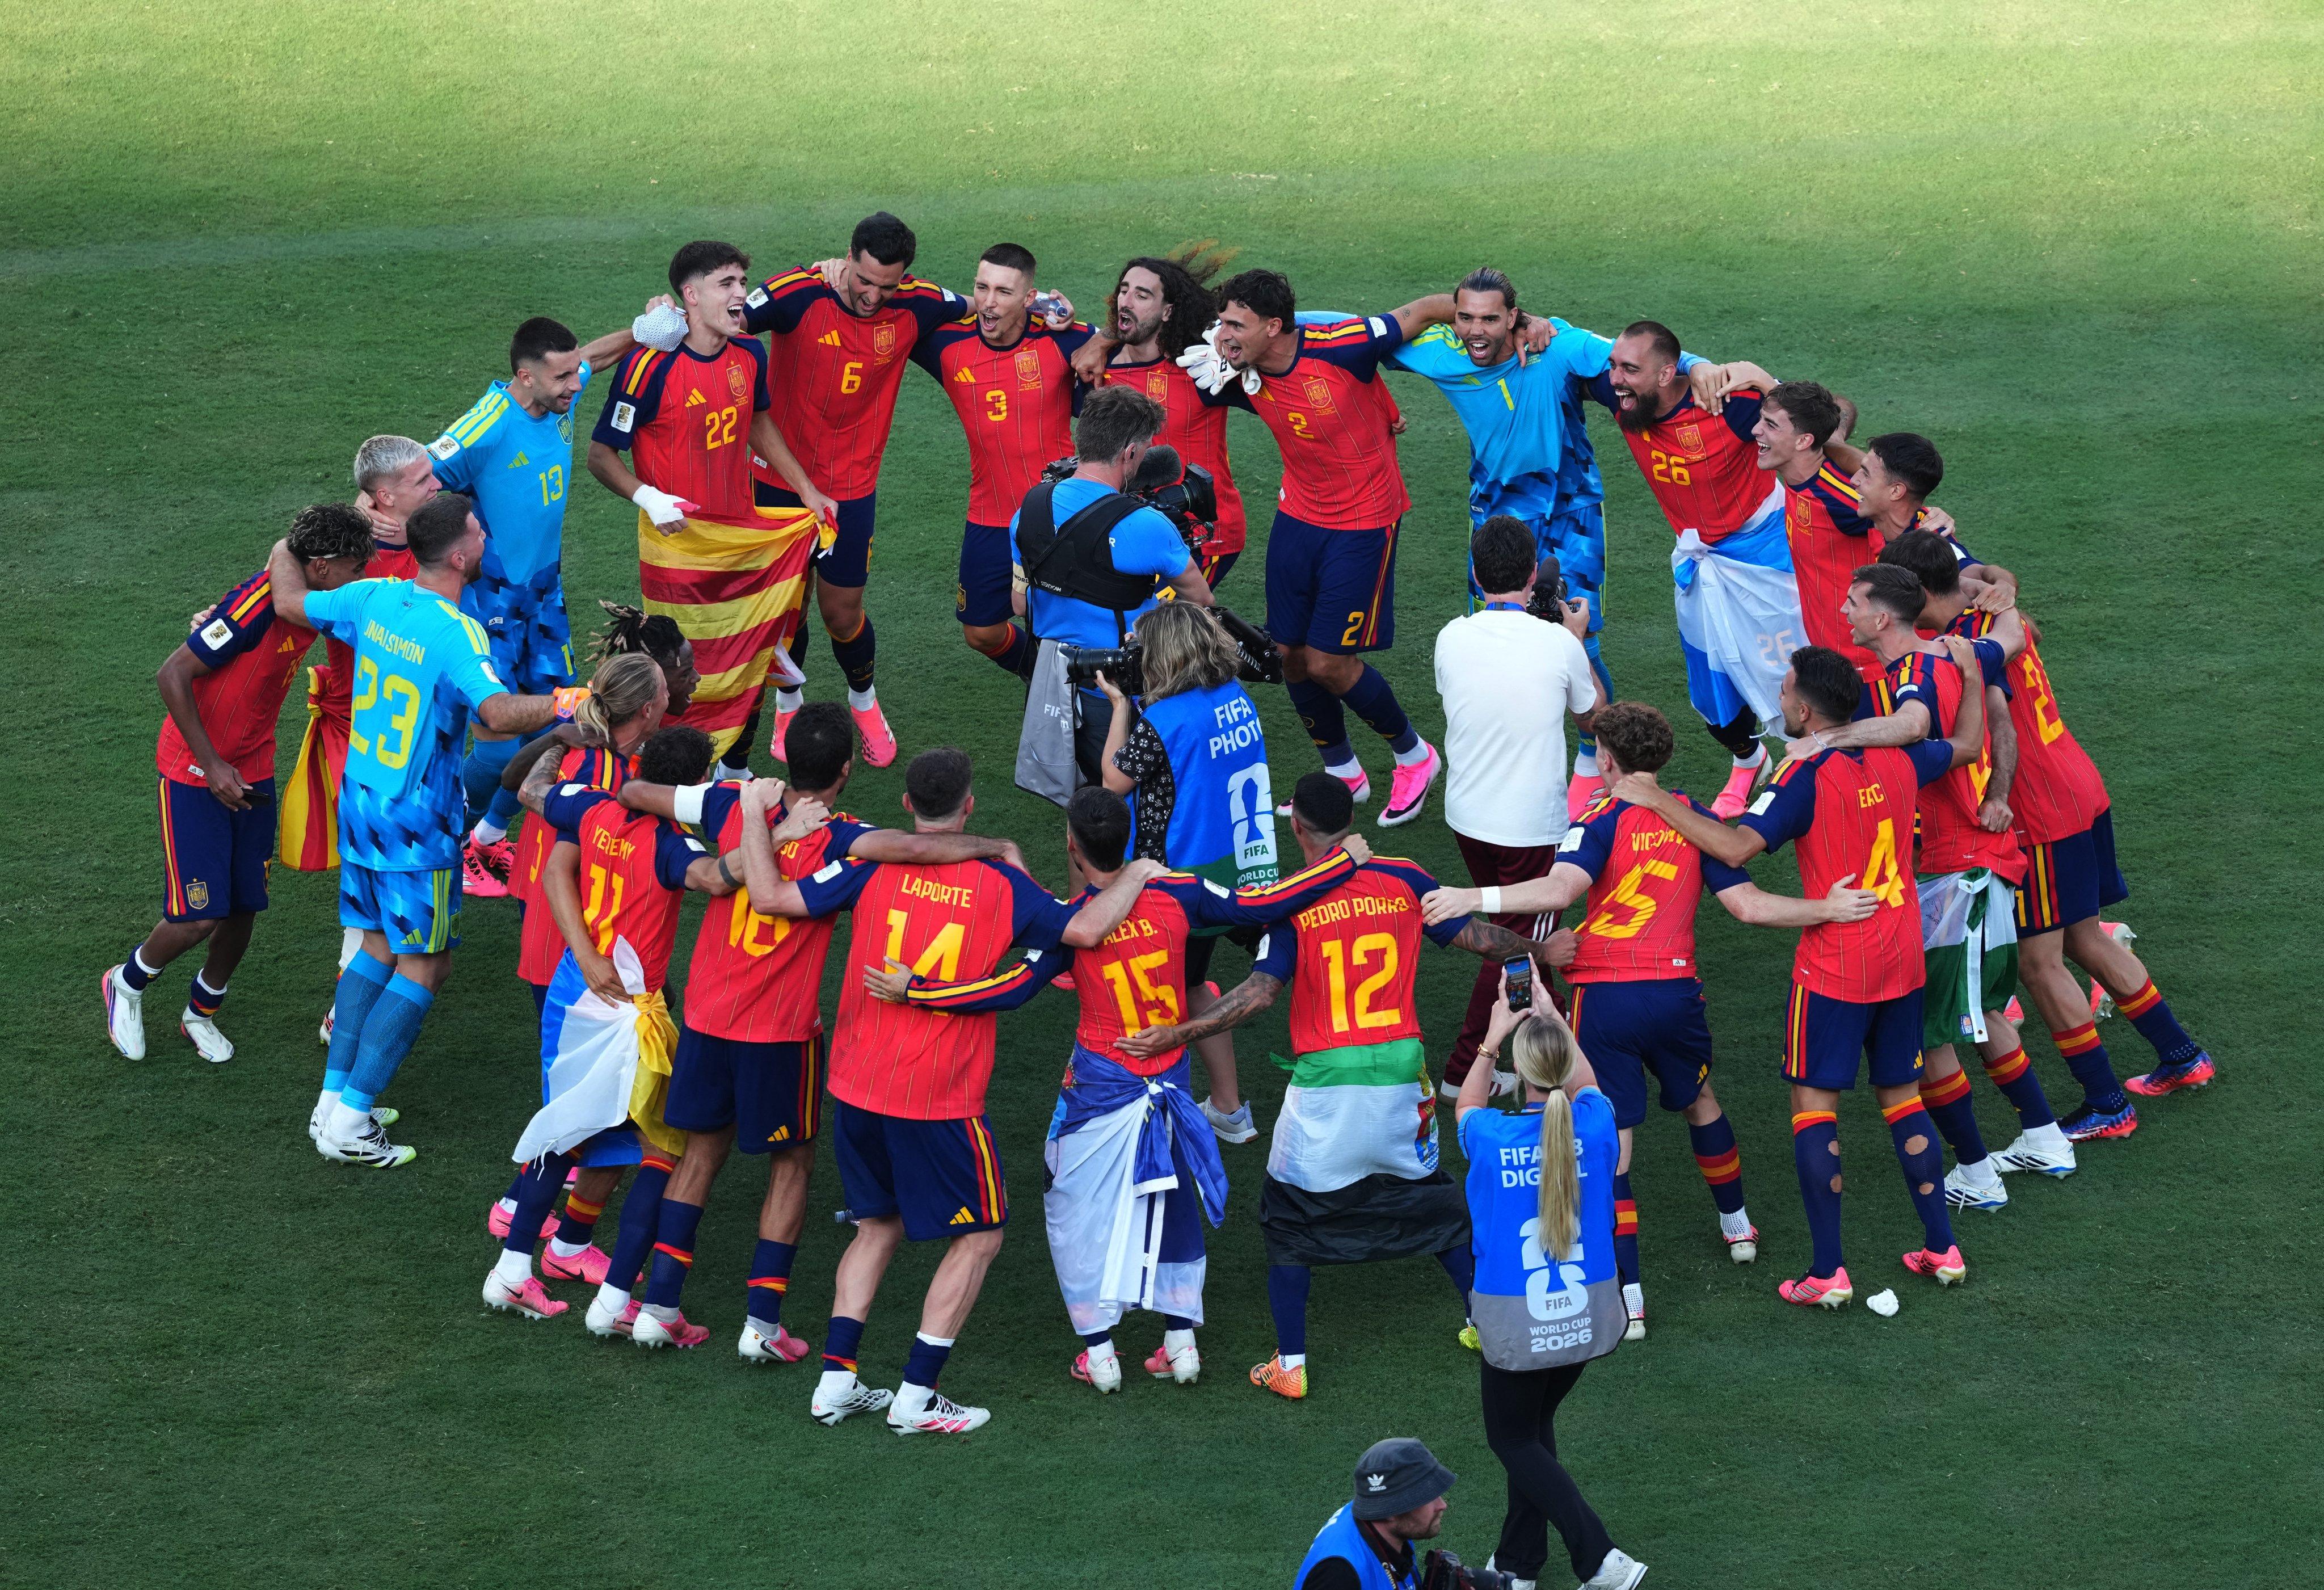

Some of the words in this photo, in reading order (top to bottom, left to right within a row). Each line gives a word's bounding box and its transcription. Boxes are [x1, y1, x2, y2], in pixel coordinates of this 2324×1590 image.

[841, 361, 864, 394] 6
[1497, 378, 1514, 410] 1
[986, 390, 1007, 421] 3
[705, 406, 738, 451] 22
[1288, 413, 1315, 439] 2
[1651, 450, 1691, 486] 26
[538, 464, 564, 507] 13
[1014, 573, 1029, 583] WORL
[1041, 581, 1062, 592] STEADICAM
[1341, 611, 1365, 646] 2
[385, 634, 426, 665] SIMÓN
[350, 655, 422, 771] 23
[1044, 704, 1061, 717] FIF
[1214, 696, 1252, 729] FIFA
[1244, 844, 1269, 859] FIFA
[1862, 818, 1905, 908] 4
[901, 874, 973, 908] LAPORTE
[583, 863, 624, 956] 11
[1297, 899, 1351, 932] PEDRO
[1352, 896, 1410, 918] PORRO
[1138, 919, 1158, 937] B.
[884, 909, 966, 1016] 14
[1102, 949, 1179, 1038] 15
[1321, 932, 1402, 1033] 12
[1499, 1145, 1543, 1166] FIFA
[1545, 1296, 1572, 1311] FIFA
[1530, 1322, 1570, 1336] WORLD
[1571, 1317, 1592, 1330] CUP
[1530, 1328, 1593, 1353] 2026
